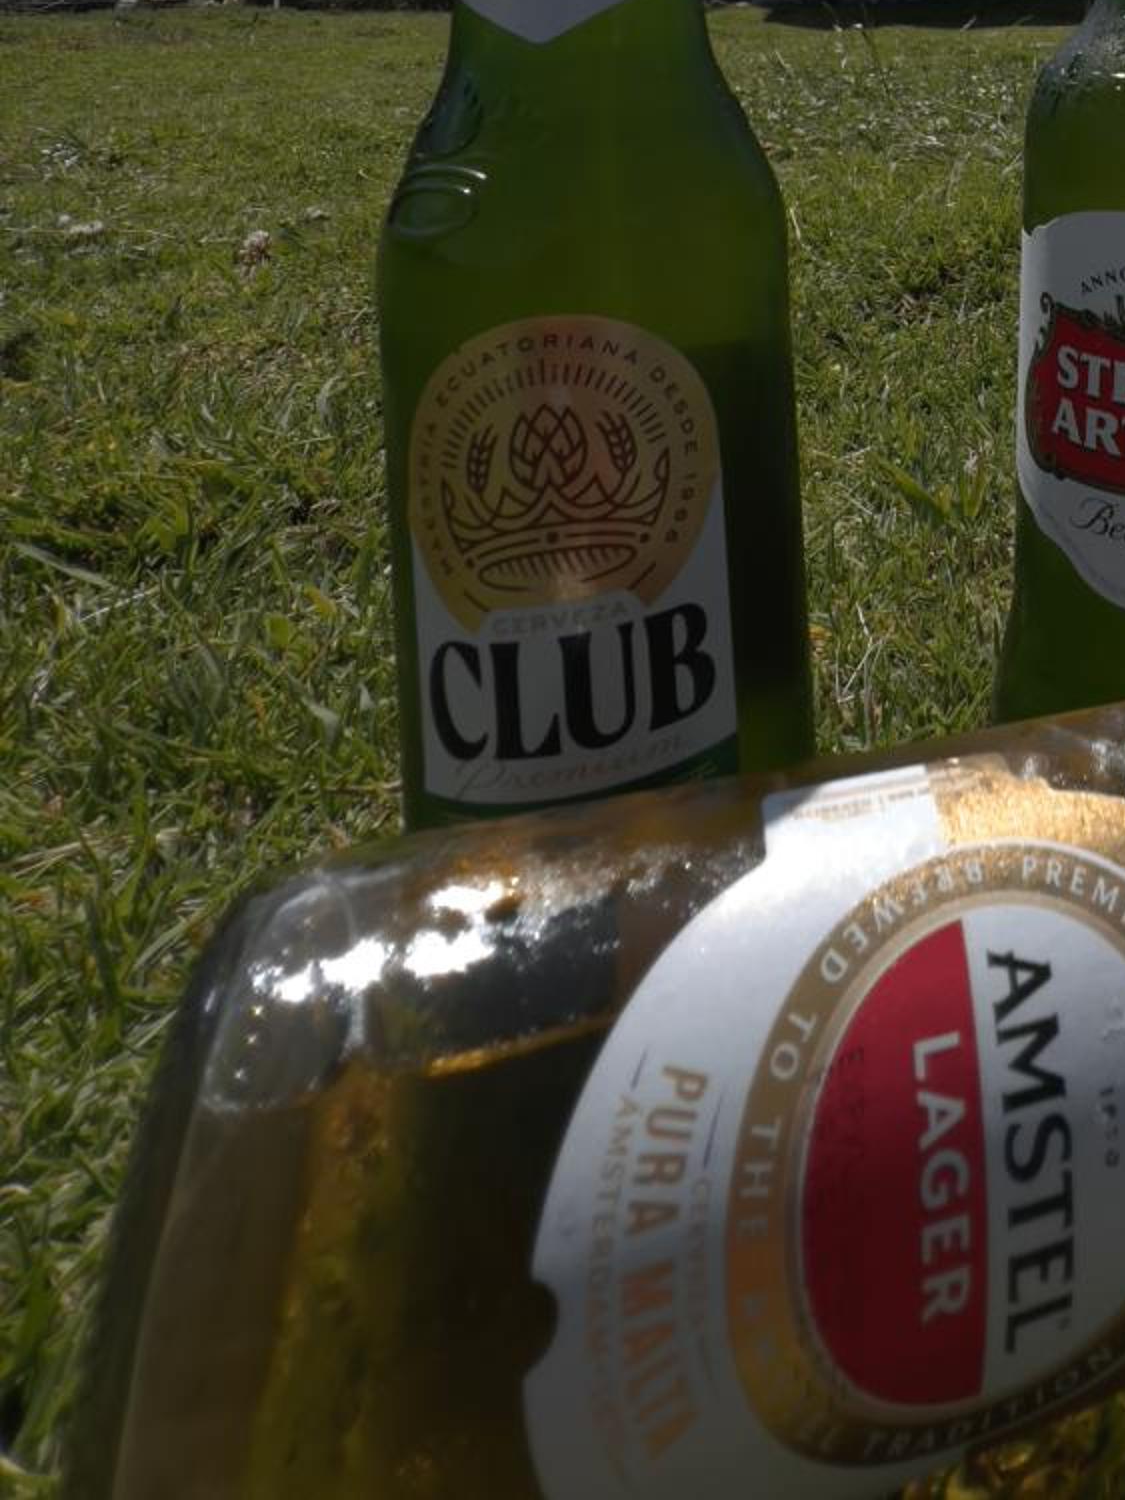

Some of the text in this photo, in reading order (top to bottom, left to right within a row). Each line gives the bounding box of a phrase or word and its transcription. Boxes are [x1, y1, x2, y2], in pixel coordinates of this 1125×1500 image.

[437, 332, 639, 406] ECUATORIANA
[430, 602, 716, 762] CLUB
[455, 734, 686, 801] Premium
[819, 856, 985, 985] BREWED
[768, 1011, 818, 1081] TO
[738, 1121, 782, 1242] THE
[909, 1031, 974, 1329] LAGER
[986, 949, 1076, 1355] AMSTEL
[619, 1062, 708, 1461] PURA MALTA
